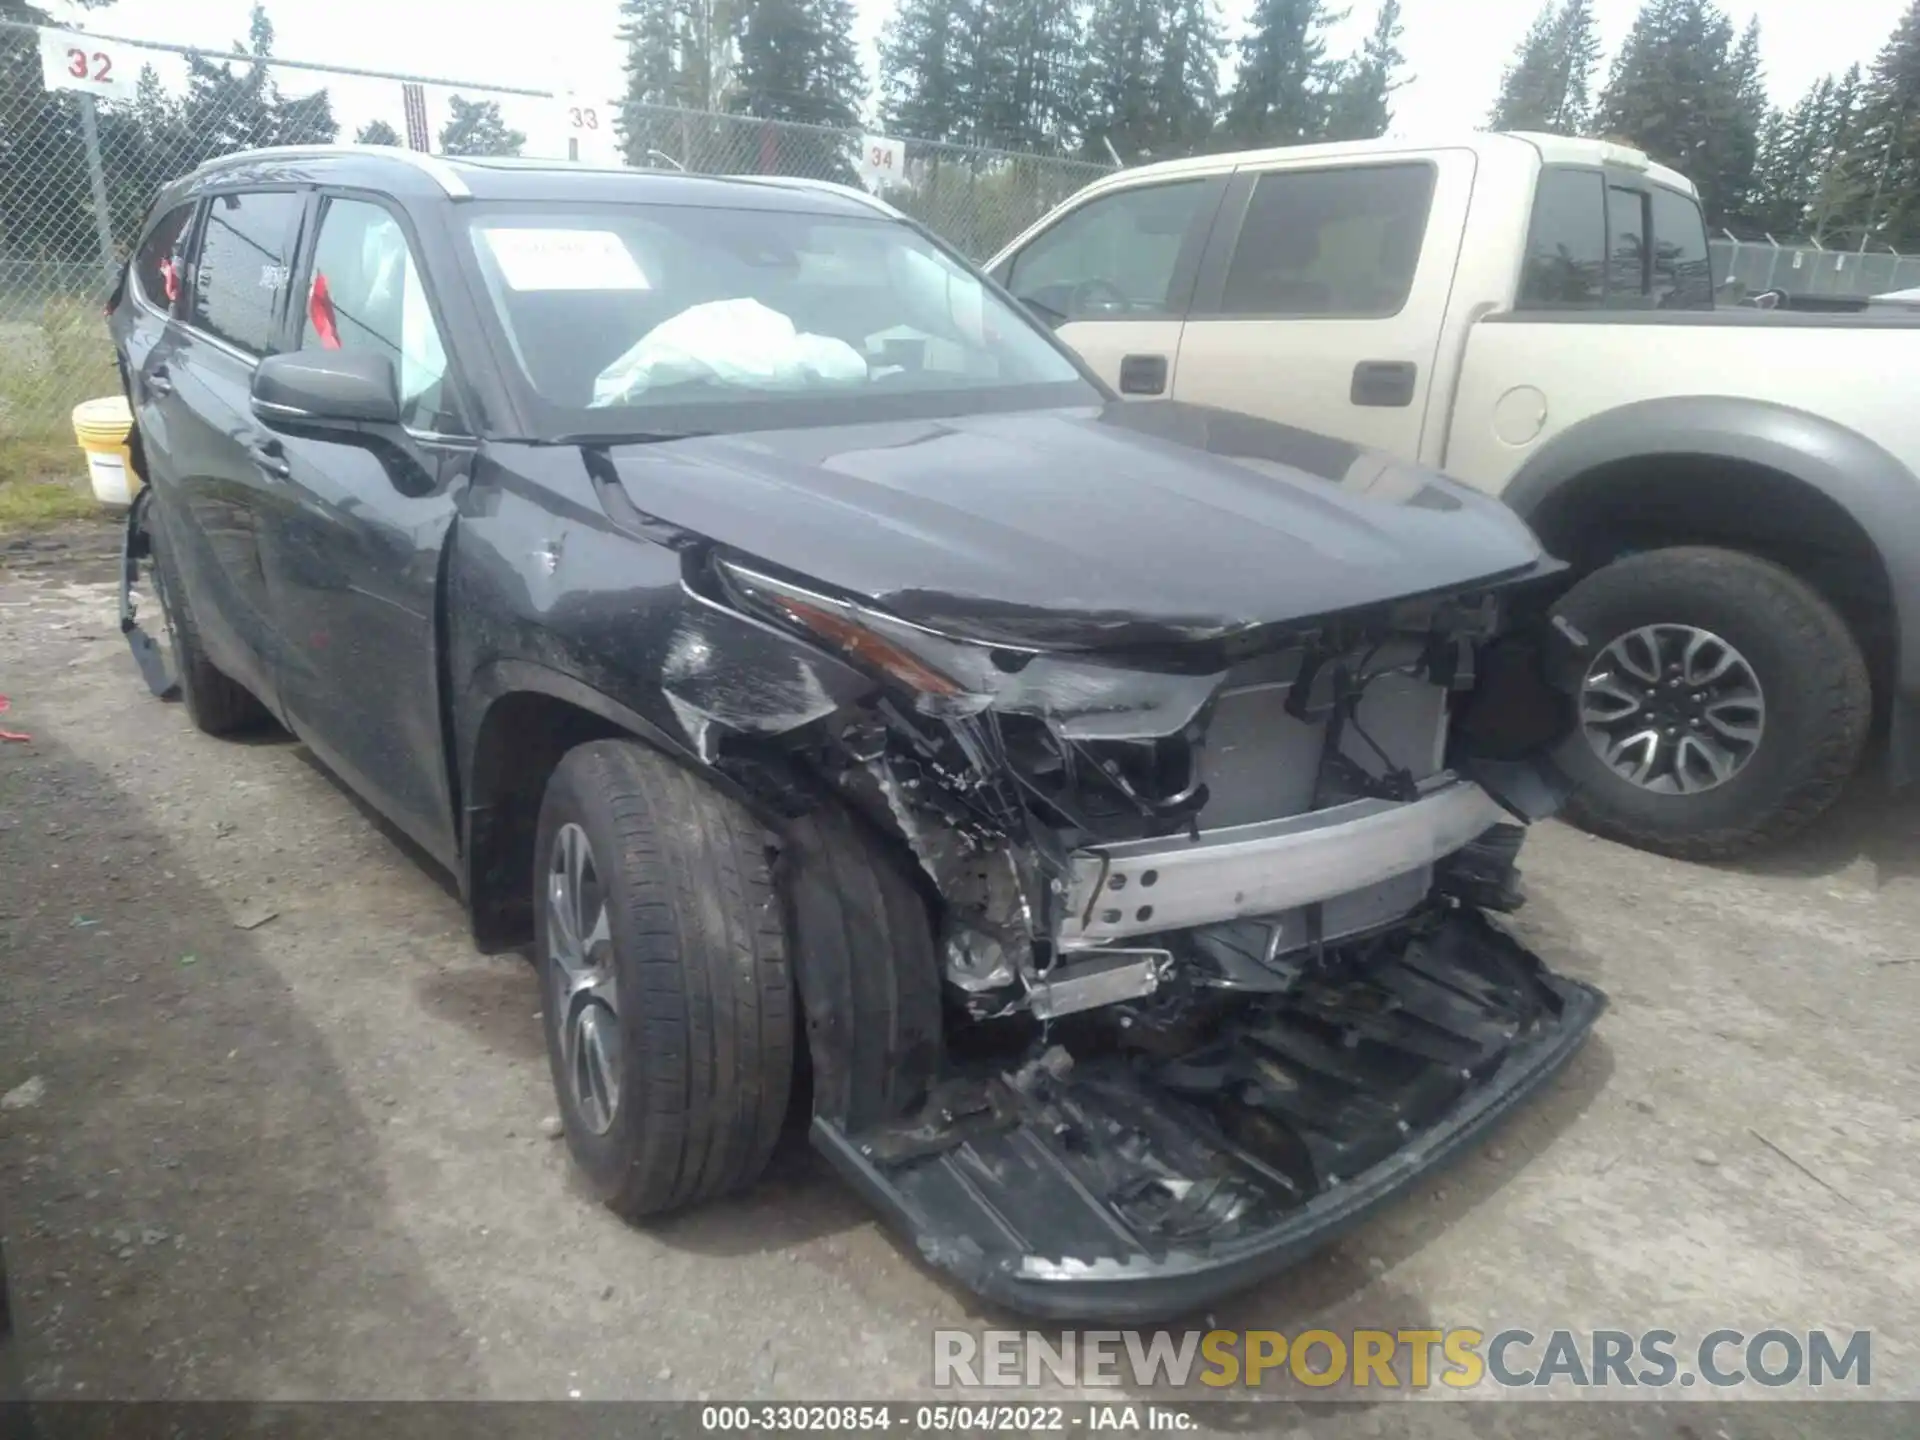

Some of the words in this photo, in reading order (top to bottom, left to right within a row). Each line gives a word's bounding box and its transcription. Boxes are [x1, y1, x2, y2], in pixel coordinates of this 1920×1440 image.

[67, 47, 114, 83] 32
[568, 106, 599, 129] 33
[871, 146, 893, 169] 34
